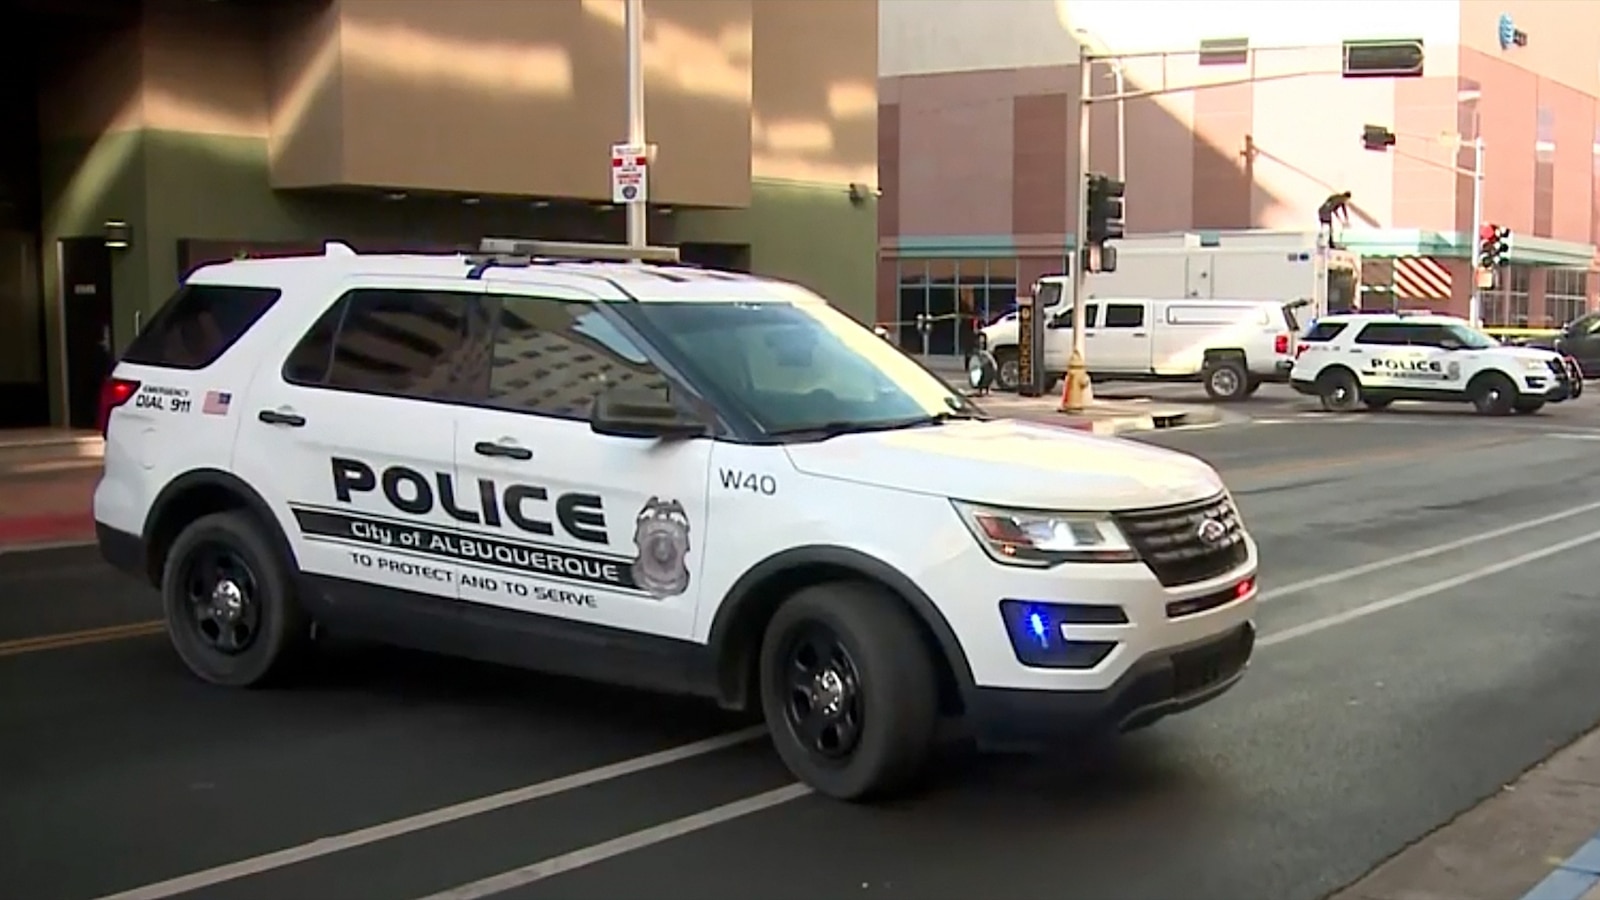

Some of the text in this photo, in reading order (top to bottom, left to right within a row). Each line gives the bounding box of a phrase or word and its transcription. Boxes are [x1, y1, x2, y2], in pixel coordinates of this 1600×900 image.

[1371, 358, 1442, 372] POLICE
[136, 395, 191, 412] DIAL 911
[331, 457, 609, 544] POLICE
[719, 467, 776, 496] W40
[350, 521, 619, 582] City of ALBUQUERQUE
[349, 551, 598, 609] TO PROTECT AND TO SERVE
